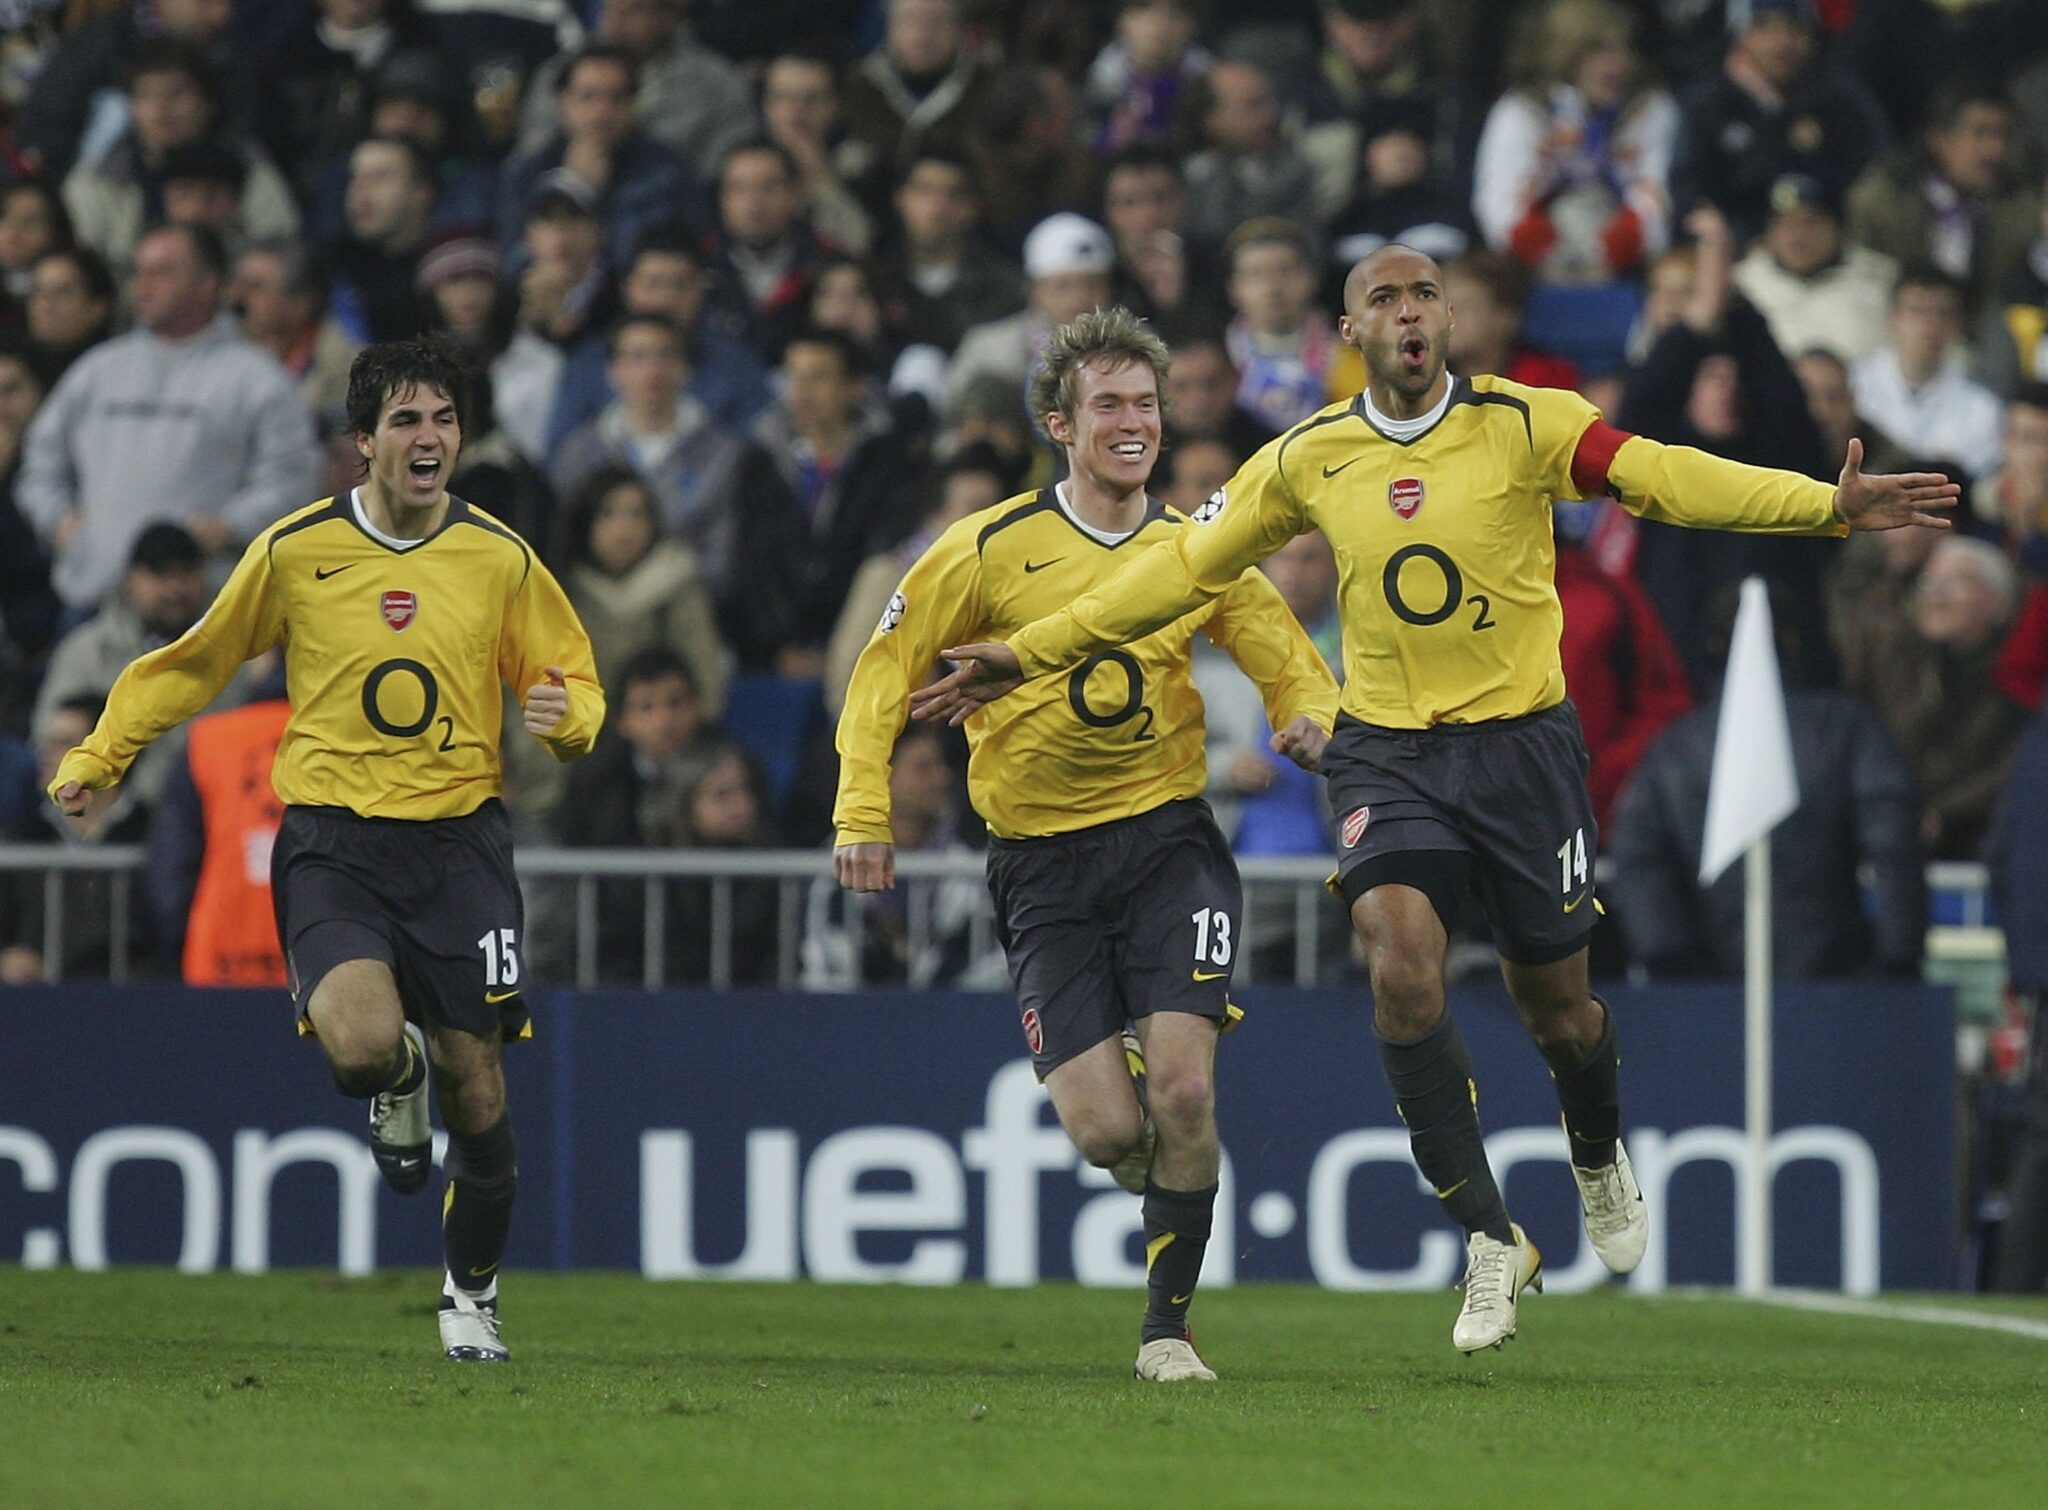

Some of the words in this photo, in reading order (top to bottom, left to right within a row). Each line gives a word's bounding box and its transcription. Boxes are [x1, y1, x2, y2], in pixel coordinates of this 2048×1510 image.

[1557, 827, 1588, 894] 14
[478, 928, 519, 986] 15
[1191, 907, 1231, 966] 13
